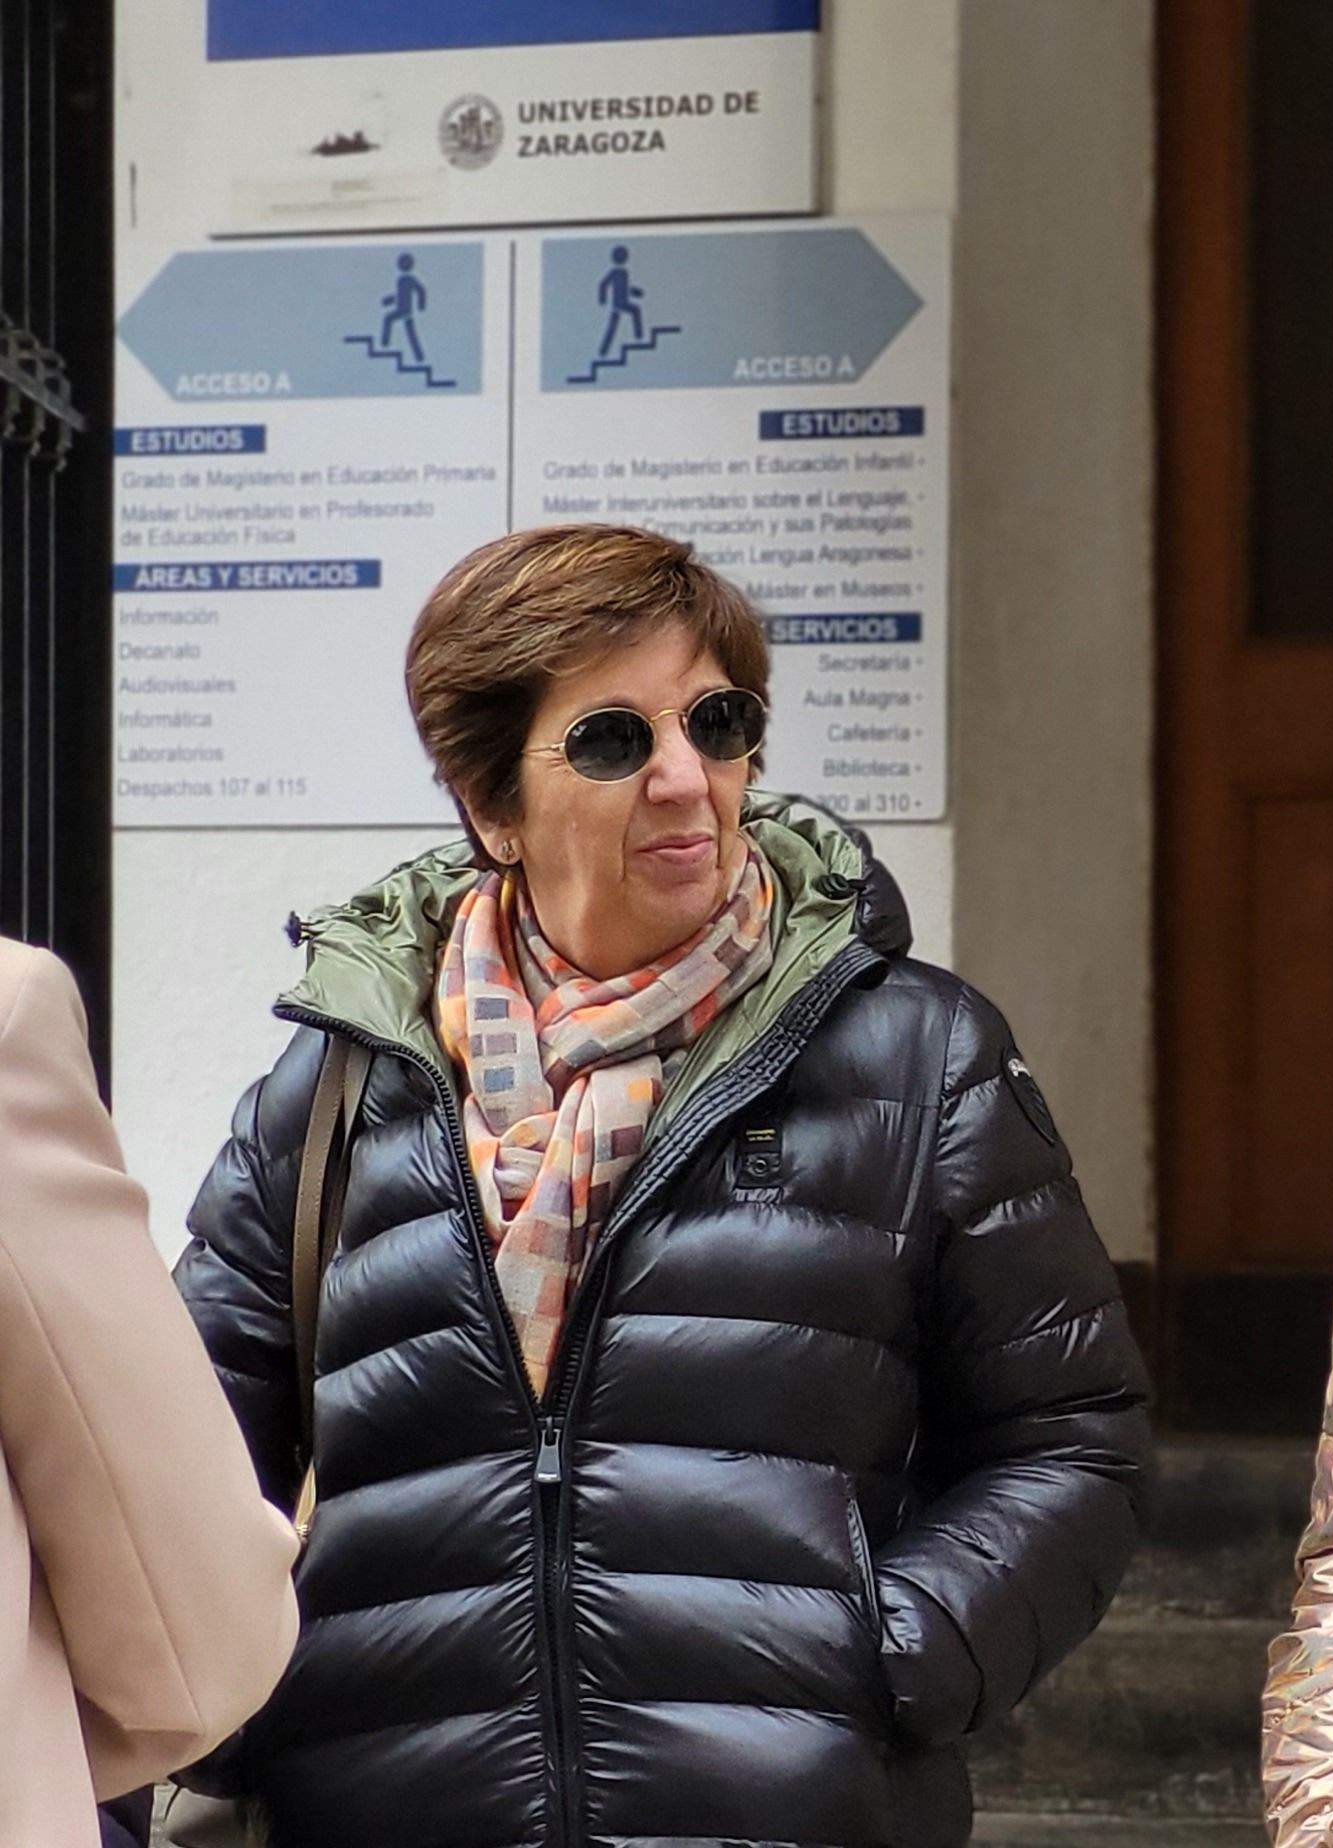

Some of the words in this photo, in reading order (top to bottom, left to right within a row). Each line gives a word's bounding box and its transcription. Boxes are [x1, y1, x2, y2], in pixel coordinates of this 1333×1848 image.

[518, 94, 714, 124] UNIVERSIDAD
[723, 91, 760, 114] DE
[518, 130, 665, 158] ZARAGOZA
[733, 358, 832, 379] ACCESO
[837, 356, 855, 376] A
[175, 376, 267, 395] ACCESO
[275, 374, 291, 392] A
[782, 412, 899, 436] ESTUDIOS
[131, 430, 244, 452] ESTUDIOS
[121, 470, 173, 490] Grado
[180, 470, 199, 488] de
[206, 466, 295, 492] Magisterio
[301, 471, 322, 486] en
[327, 464, 417, 486] Educación
[424, 463, 496, 483] Primaria
[544, 460, 598, 481] Grado
[603, 459, 625, 478] de
[631, 457, 722, 482] Magisterio
[728, 461, 749, 475] en
[756, 453, 848, 475] Educación
[854, 451, 913, 471] Infantil
[753, 489, 801, 508] sobre
[121, 501, 179, 524] Máster
[185, 500, 293, 521] Universitario
[299, 504, 321, 519] en
[327, 499, 434, 519] Profesorado
[121, 527, 143, 546] de
[148, 525, 238, 546] Educación
[244, 523, 295, 544] Física
[219, 564, 232, 586] Y
[240, 561, 358, 585] SERVICIOS
[119, 605, 218, 626] Información
[771, 618, 898, 640] SERVICIOS
[118, 641, 201, 660] Decanato
[119, 675, 236, 694] Audiovisuales
[803, 690, 842, 709] Aula
[850, 690, 910, 710] Magna
[118, 710, 211, 728] Informática
[117, 743, 222, 763] Laboratorios
[822, 758, 910, 778] Biblioteca
[117, 778, 212, 798] Despachos
[219, 777, 249, 796] 107
[276, 776, 306, 796] 115
[855, 793, 870, 813] al
[876, 792, 911, 813] 310
